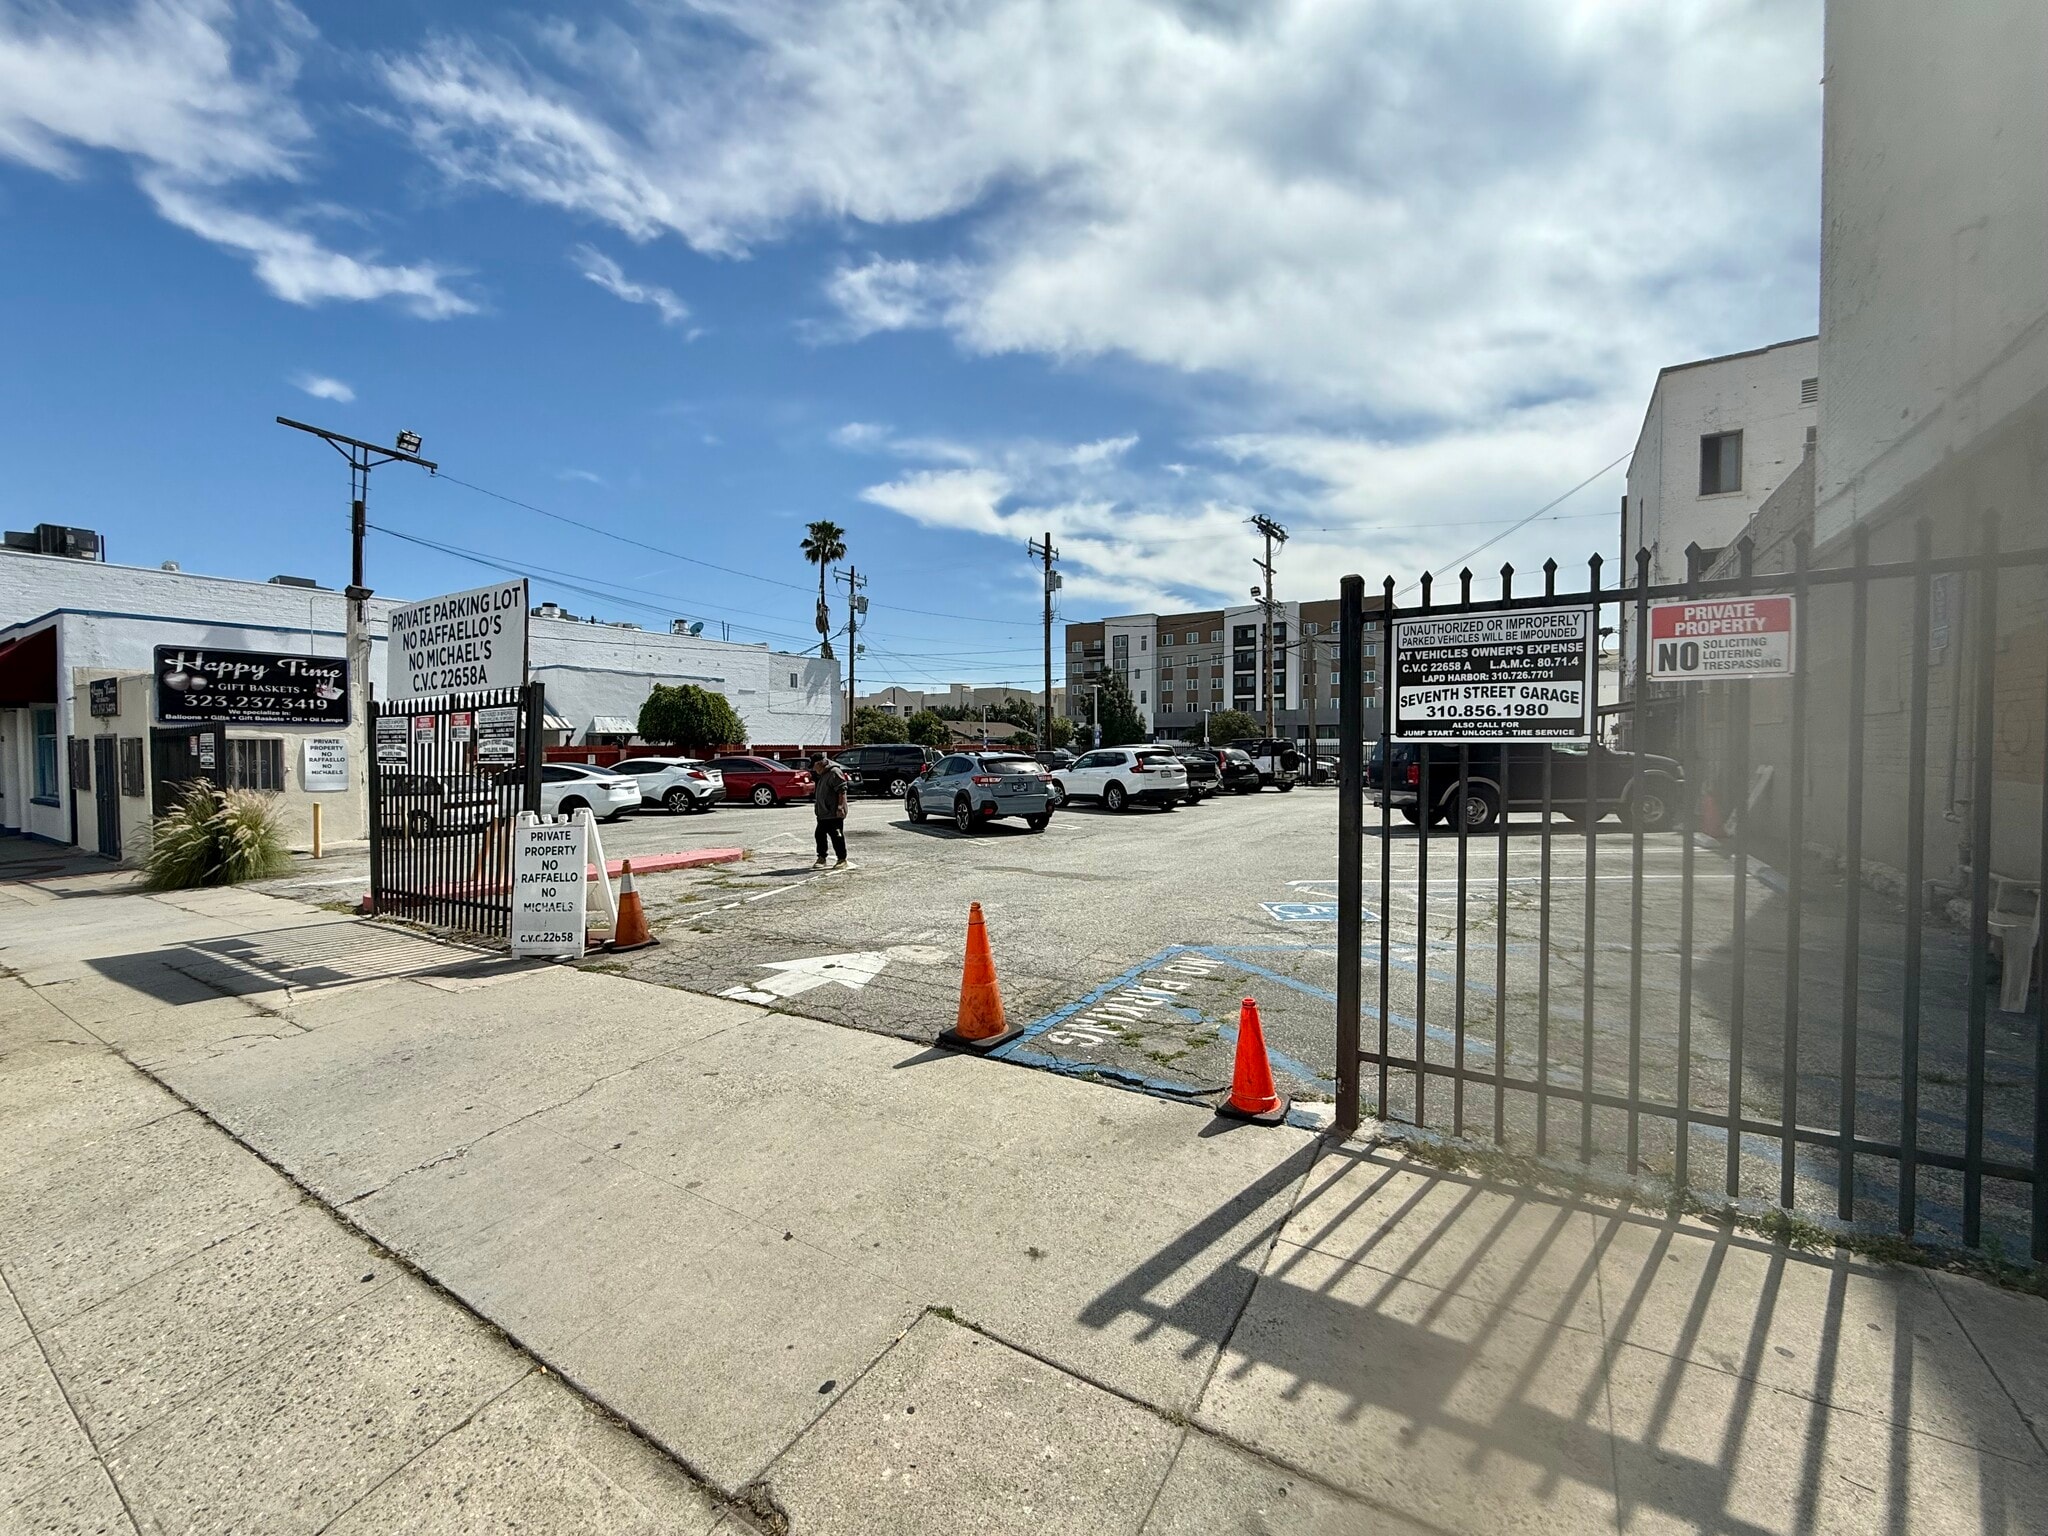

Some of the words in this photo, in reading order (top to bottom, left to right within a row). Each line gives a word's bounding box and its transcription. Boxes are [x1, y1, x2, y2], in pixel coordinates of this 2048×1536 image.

[392, 606, 431, 632] PRIVATE
[434, 593, 489, 622] PARKING
[494, 586, 520, 610] LOT
[1684, 603, 1755, 620] PRIVATE
[403, 631, 417, 651] NO
[420, 614, 501, 647] RAFFAELLO'S
[1402, 621, 1484, 636] UNAUTHORIZED
[1487, 619, 1503, 631] OR
[1506, 614, 1580, 629] IMPROPERLY
[1674, 617, 1767, 636] PROPERTY
[1402, 636, 1435, 646] PARKED
[1438, 633, 1479, 644] VEHICLES
[1482, 632, 1503, 641] WILL
[1506, 631, 1518, 640] BE
[1521, 627, 1577, 640] IMPOUNDED
[1703, 637, 1767, 649] SOLICITING
[409, 651, 424, 671] NO
[427, 640, 491, 668] MICHAEL'S
[1399, 651, 1412, 661] AT
[1415, 648, 1468, 660] VEHICLES
[1471, 645, 1524, 657] OWNER'S
[1527, 642, 1584, 654] EXPENSE
[1658, 641, 1699, 672] NO
[1703, 648, 1762, 660] LOITERING
[164, 652, 270, 680] Happy
[277, 658, 342, 678] Time
[1402, 663, 1428, 673] C.V.C
[1430, 661, 1461, 672] 22658
[1463, 661, 1472, 670] A
[1490, 658, 1534, 669] L.A.M.C.
[1537, 656, 1579, 667] 80.71.4
[1703, 658, 1782, 670] TRESPASSING
[413, 671, 438, 692] C.V.C
[441, 664, 487, 689] 22658A
[1422, 674, 1445, 683] LAPD
[1448, 673, 1489, 682] HARBOR:
[1491, 670, 1554, 680] 310.726.7701
[218, 683, 246, 691] GIFT
[249, 684, 300, 694] BASKETS
[1400, 688, 1459, 708] SEVENTH
[1464, 686, 1516, 699] STREET
[1520, 686, 1579, 704] GARAGE
[184, 694, 328, 710] 323.237.3419
[1426, 703, 1549, 717] 310.856.1980
[530, 831, 571, 841] PRIVATE
[524, 845, 577, 856] PROPERTY
[541, 860, 558, 871] NO
[521, 872, 578, 883] RAFFAELLO
[541, 887, 556, 897] NO
[523, 902, 573, 912] MICHAELS
[1164, 956, 1225, 975] NO
[1047, 978, 1192, 1047] PARKING
